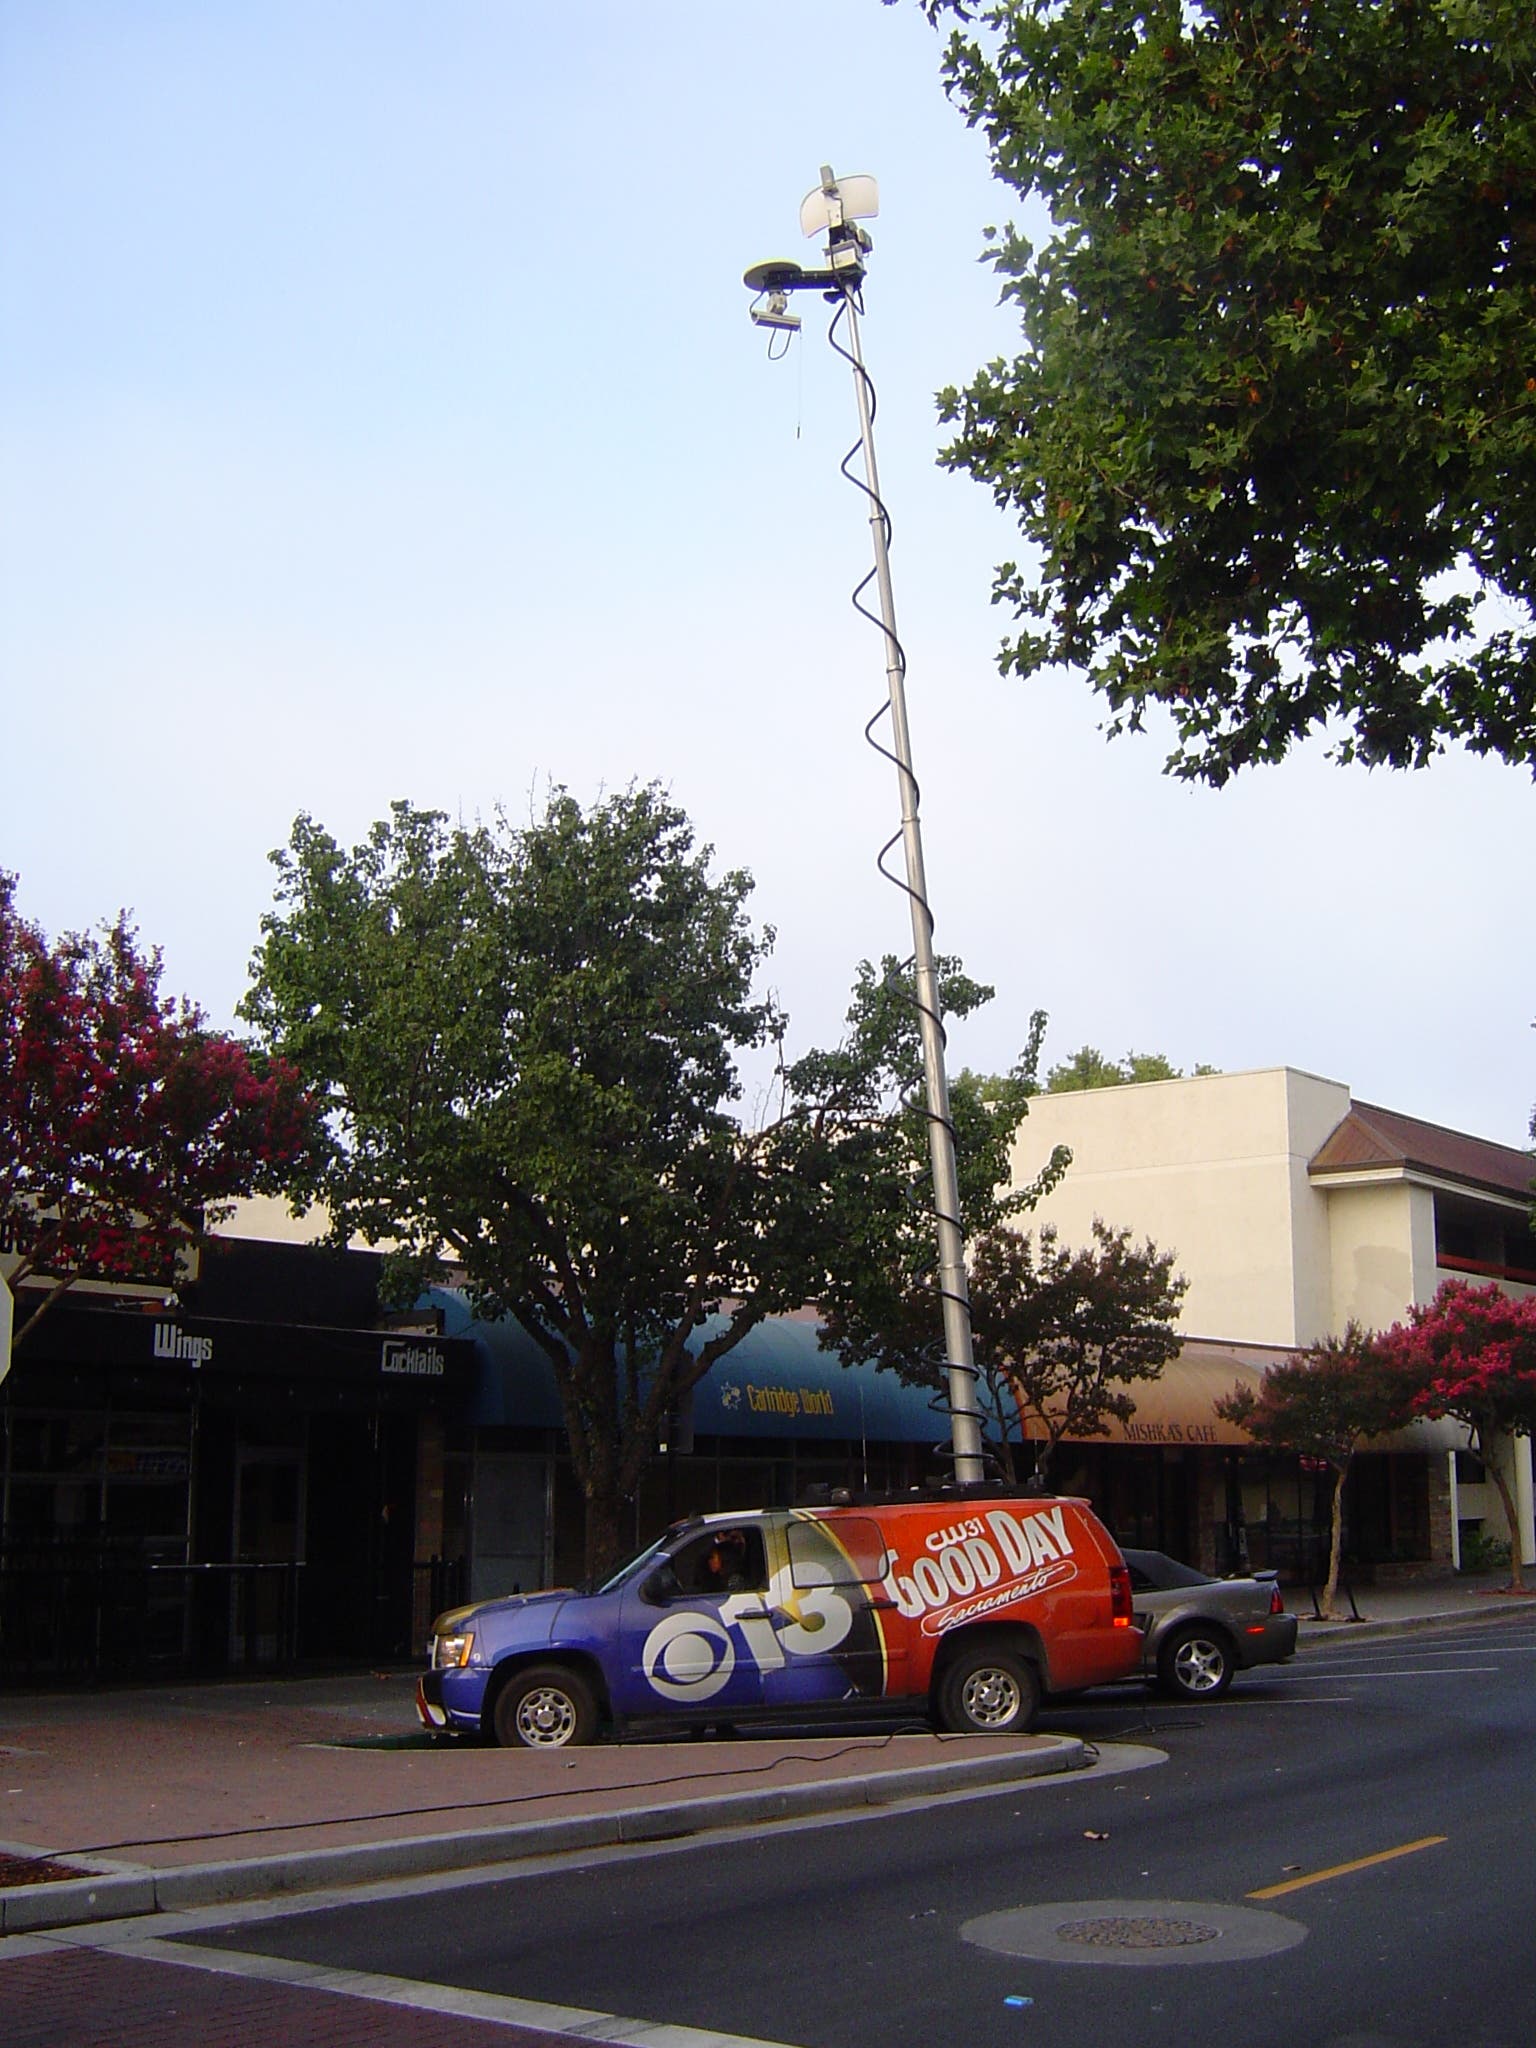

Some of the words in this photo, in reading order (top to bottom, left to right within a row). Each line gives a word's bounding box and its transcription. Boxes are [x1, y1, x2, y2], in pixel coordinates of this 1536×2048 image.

[154, 1323, 213, 1368] Wings
[382, 1340, 445, 1375] Cocktails
[746, 1384, 799, 1418] Cartridge
[800, 1387, 834, 1415] World
[879, 1537, 1001, 1618] GOOD
[985, 1505, 1074, 1576] DAY
[717, 1561, 853, 1671] 13
[937, 1566, 1066, 1636] Sacramento
